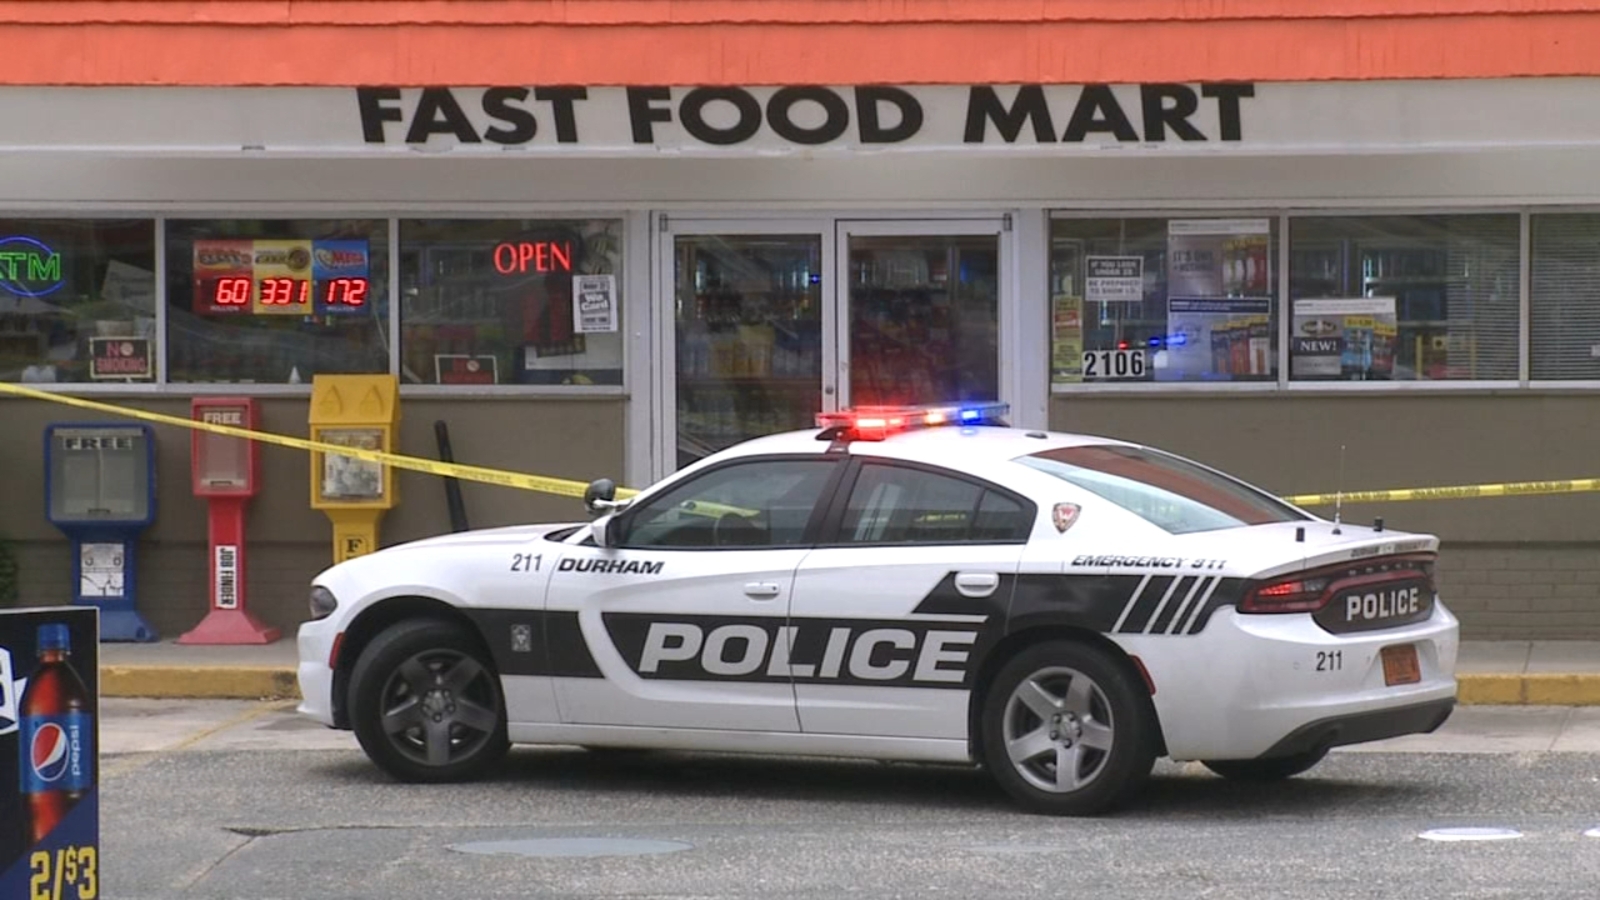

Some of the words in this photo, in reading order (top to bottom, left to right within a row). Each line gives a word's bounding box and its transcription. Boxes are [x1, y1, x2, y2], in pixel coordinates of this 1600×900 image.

[356, 86, 588, 144] FAST
[626, 85, 924, 145] FOOD
[963, 82, 1256, 143] MART
[0, 252, 61, 280] TM
[494, 241, 571, 274] OPEN
[216, 279, 250, 305] 60
[260, 279, 309, 305] 331
[326, 279, 367, 305] 172
[1300, 339, 1338, 351] NEW!
[96, 357, 147, 372] SMOKING
[1084, 351, 1143, 376] 2106
[204, 412, 241, 425] FREE
[64, 437, 131, 450] FREE
[220, 547, 235, 568] JOB
[510, 553, 543, 572] 211
[557, 557, 666, 575] DURHAM
[1071, 555, 1188, 569] EMERGENCY
[220, 570, 235, 605] FINDER
[1346, 587, 1419, 622] POLICE
[638, 621, 978, 684] POLICE
[1315, 651, 1343, 672] 211
[69, 724, 81, 777] pepsi
[30, 845, 97, 900] 2/$3
